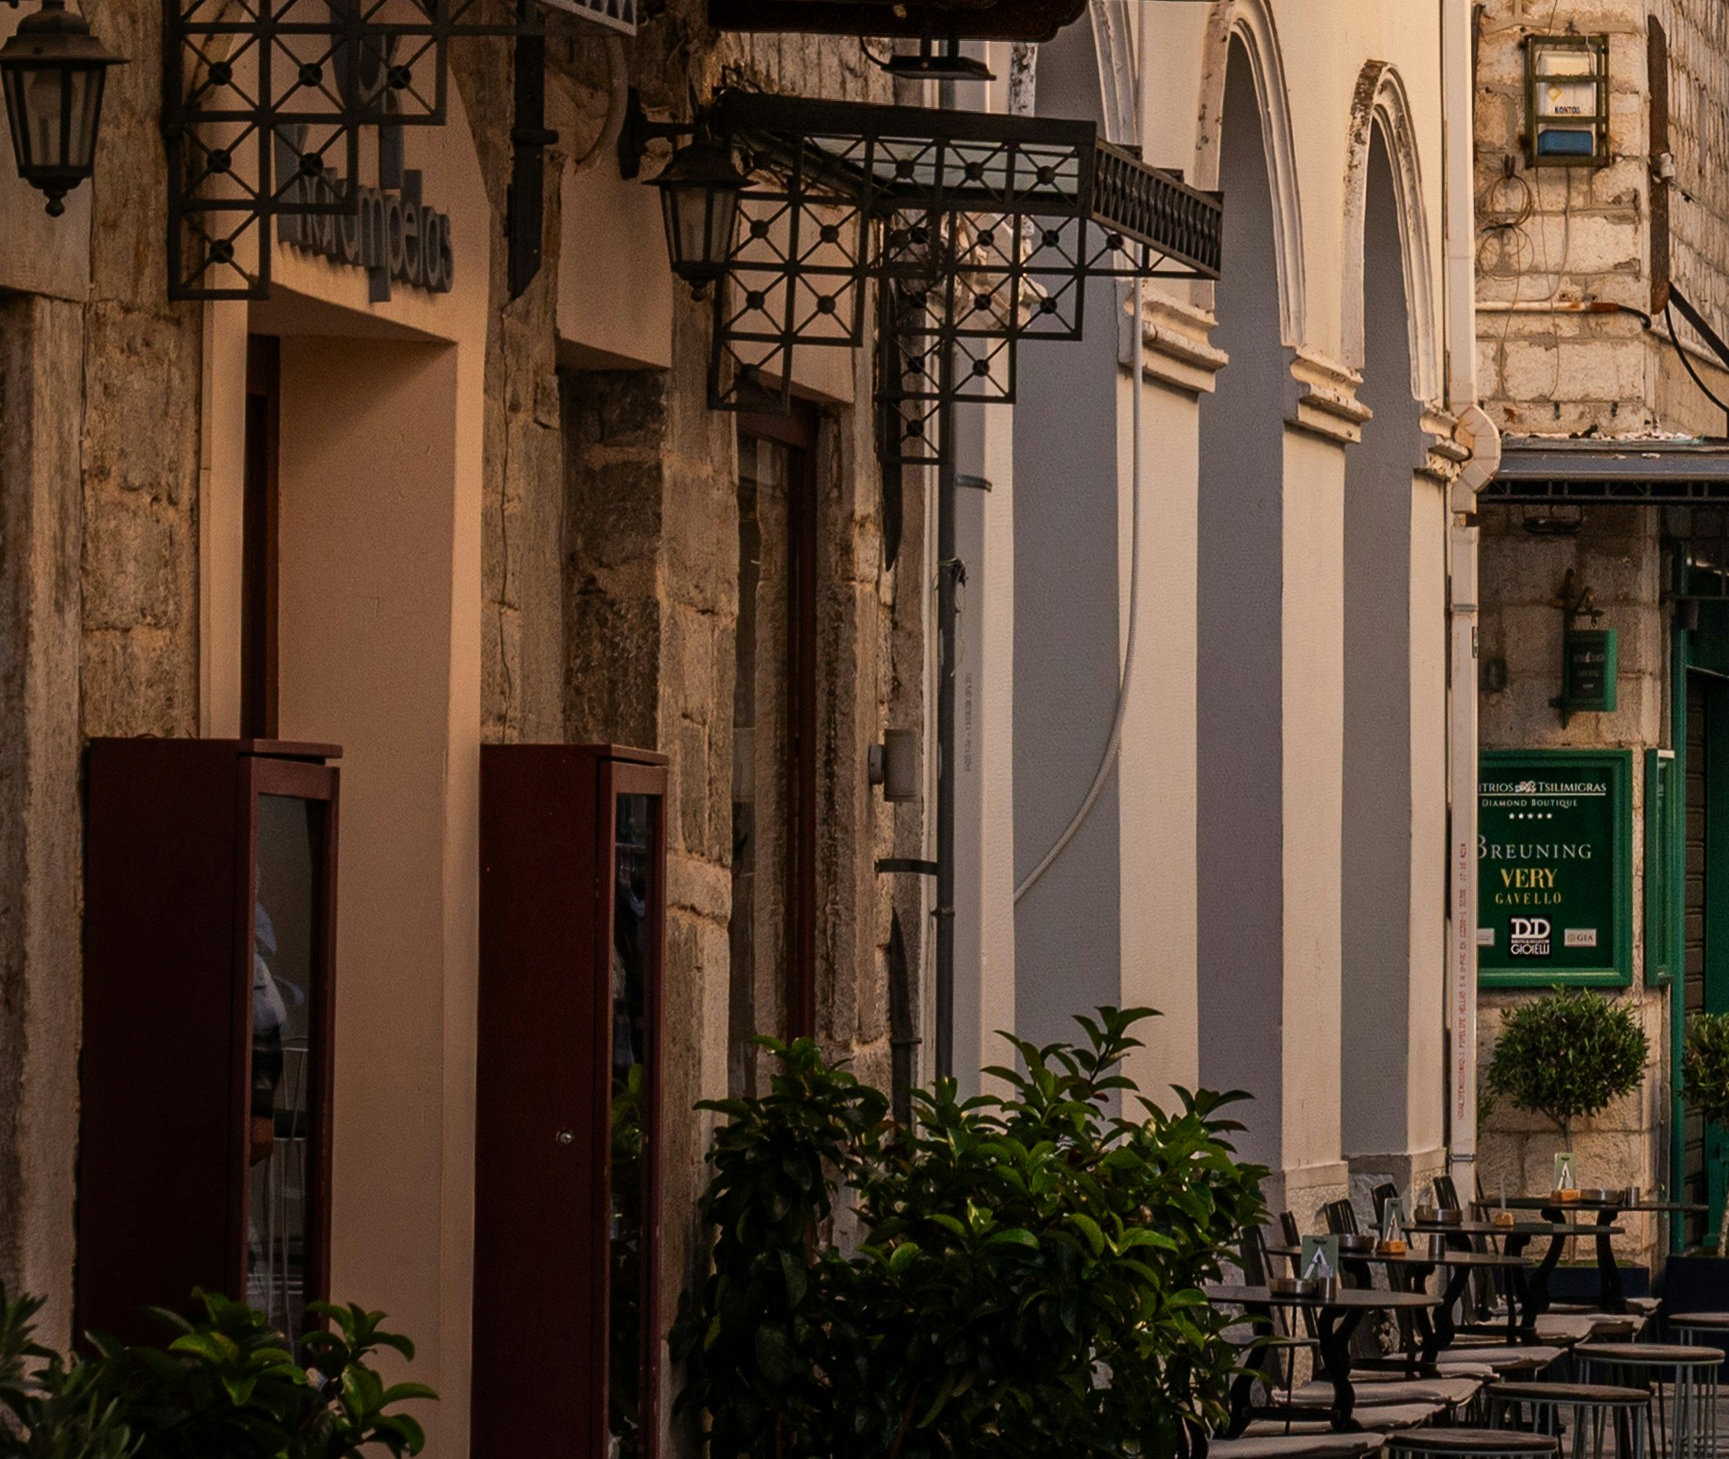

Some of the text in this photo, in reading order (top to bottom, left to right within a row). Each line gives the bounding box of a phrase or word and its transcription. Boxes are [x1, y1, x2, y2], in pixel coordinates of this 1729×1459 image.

[1481, 798, 1578, 808] DIAMOND BOUTIQUE
[1500, 868, 1558, 889] VERY
[1495, 892, 1562, 905] GAVELLO
